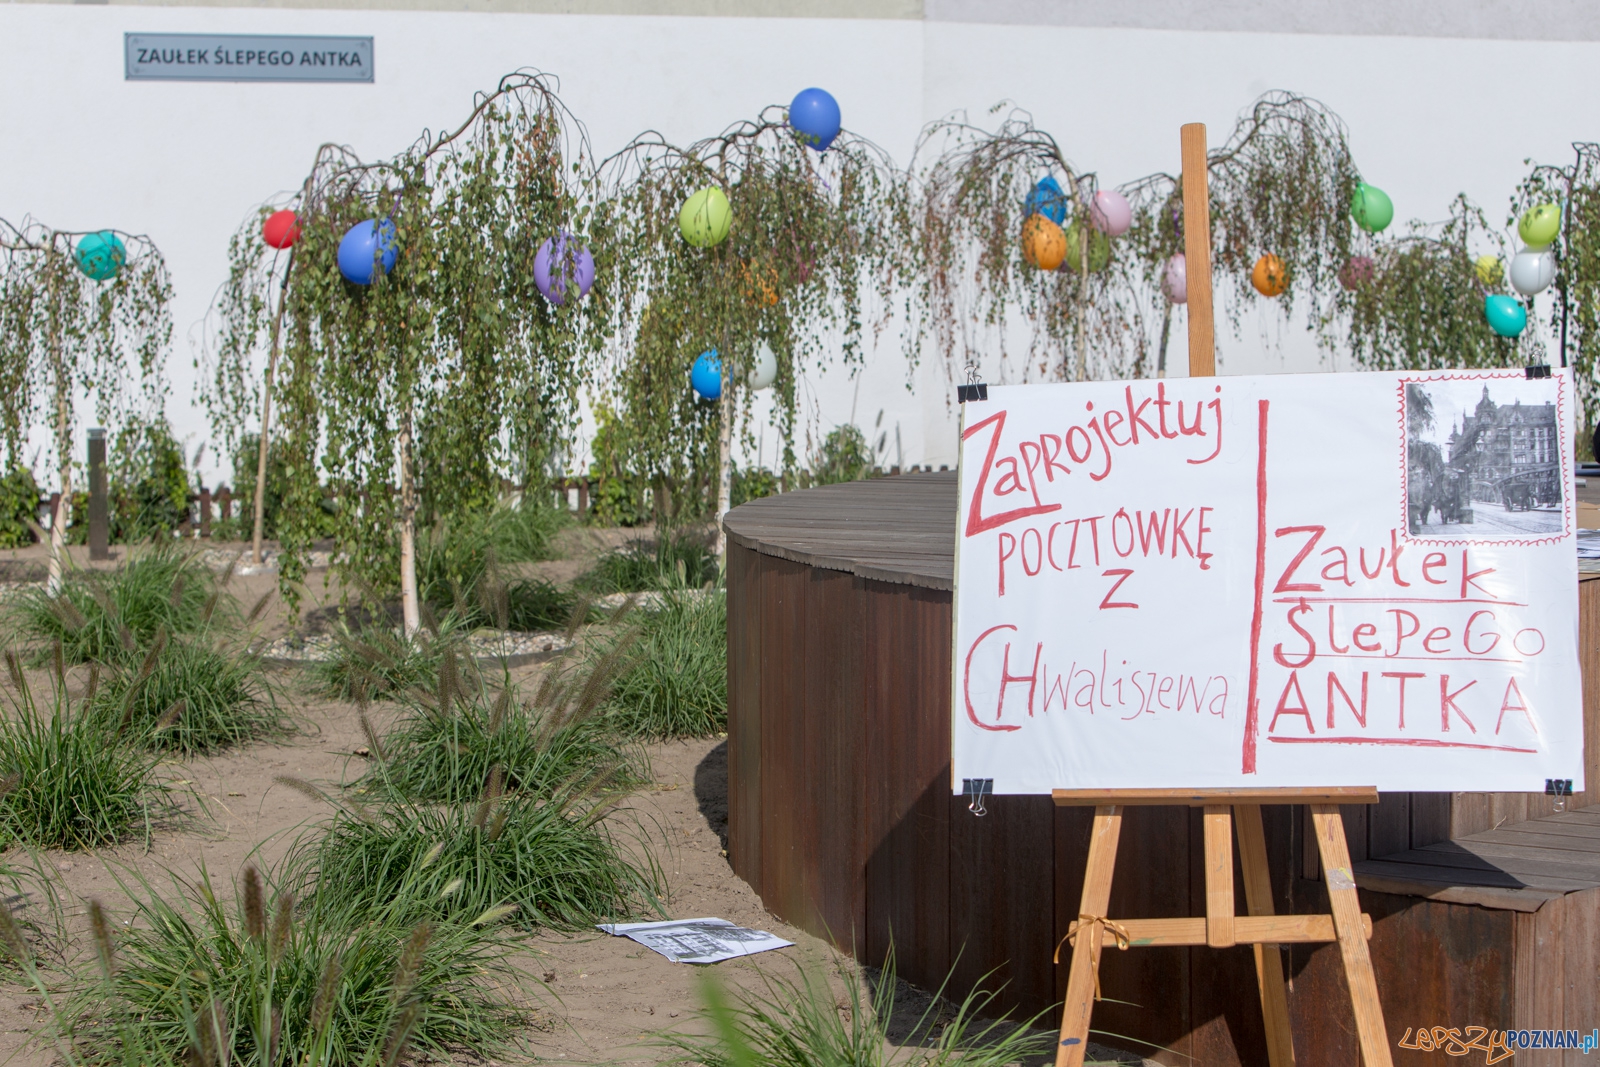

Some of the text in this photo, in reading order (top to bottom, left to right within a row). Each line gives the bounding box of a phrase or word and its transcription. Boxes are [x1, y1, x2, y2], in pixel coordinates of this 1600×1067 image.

[137, 45, 362, 67] ZAUŁEK ŚLEPEGO ANTKA
[1268, 669, 1538, 735] ANTKA
